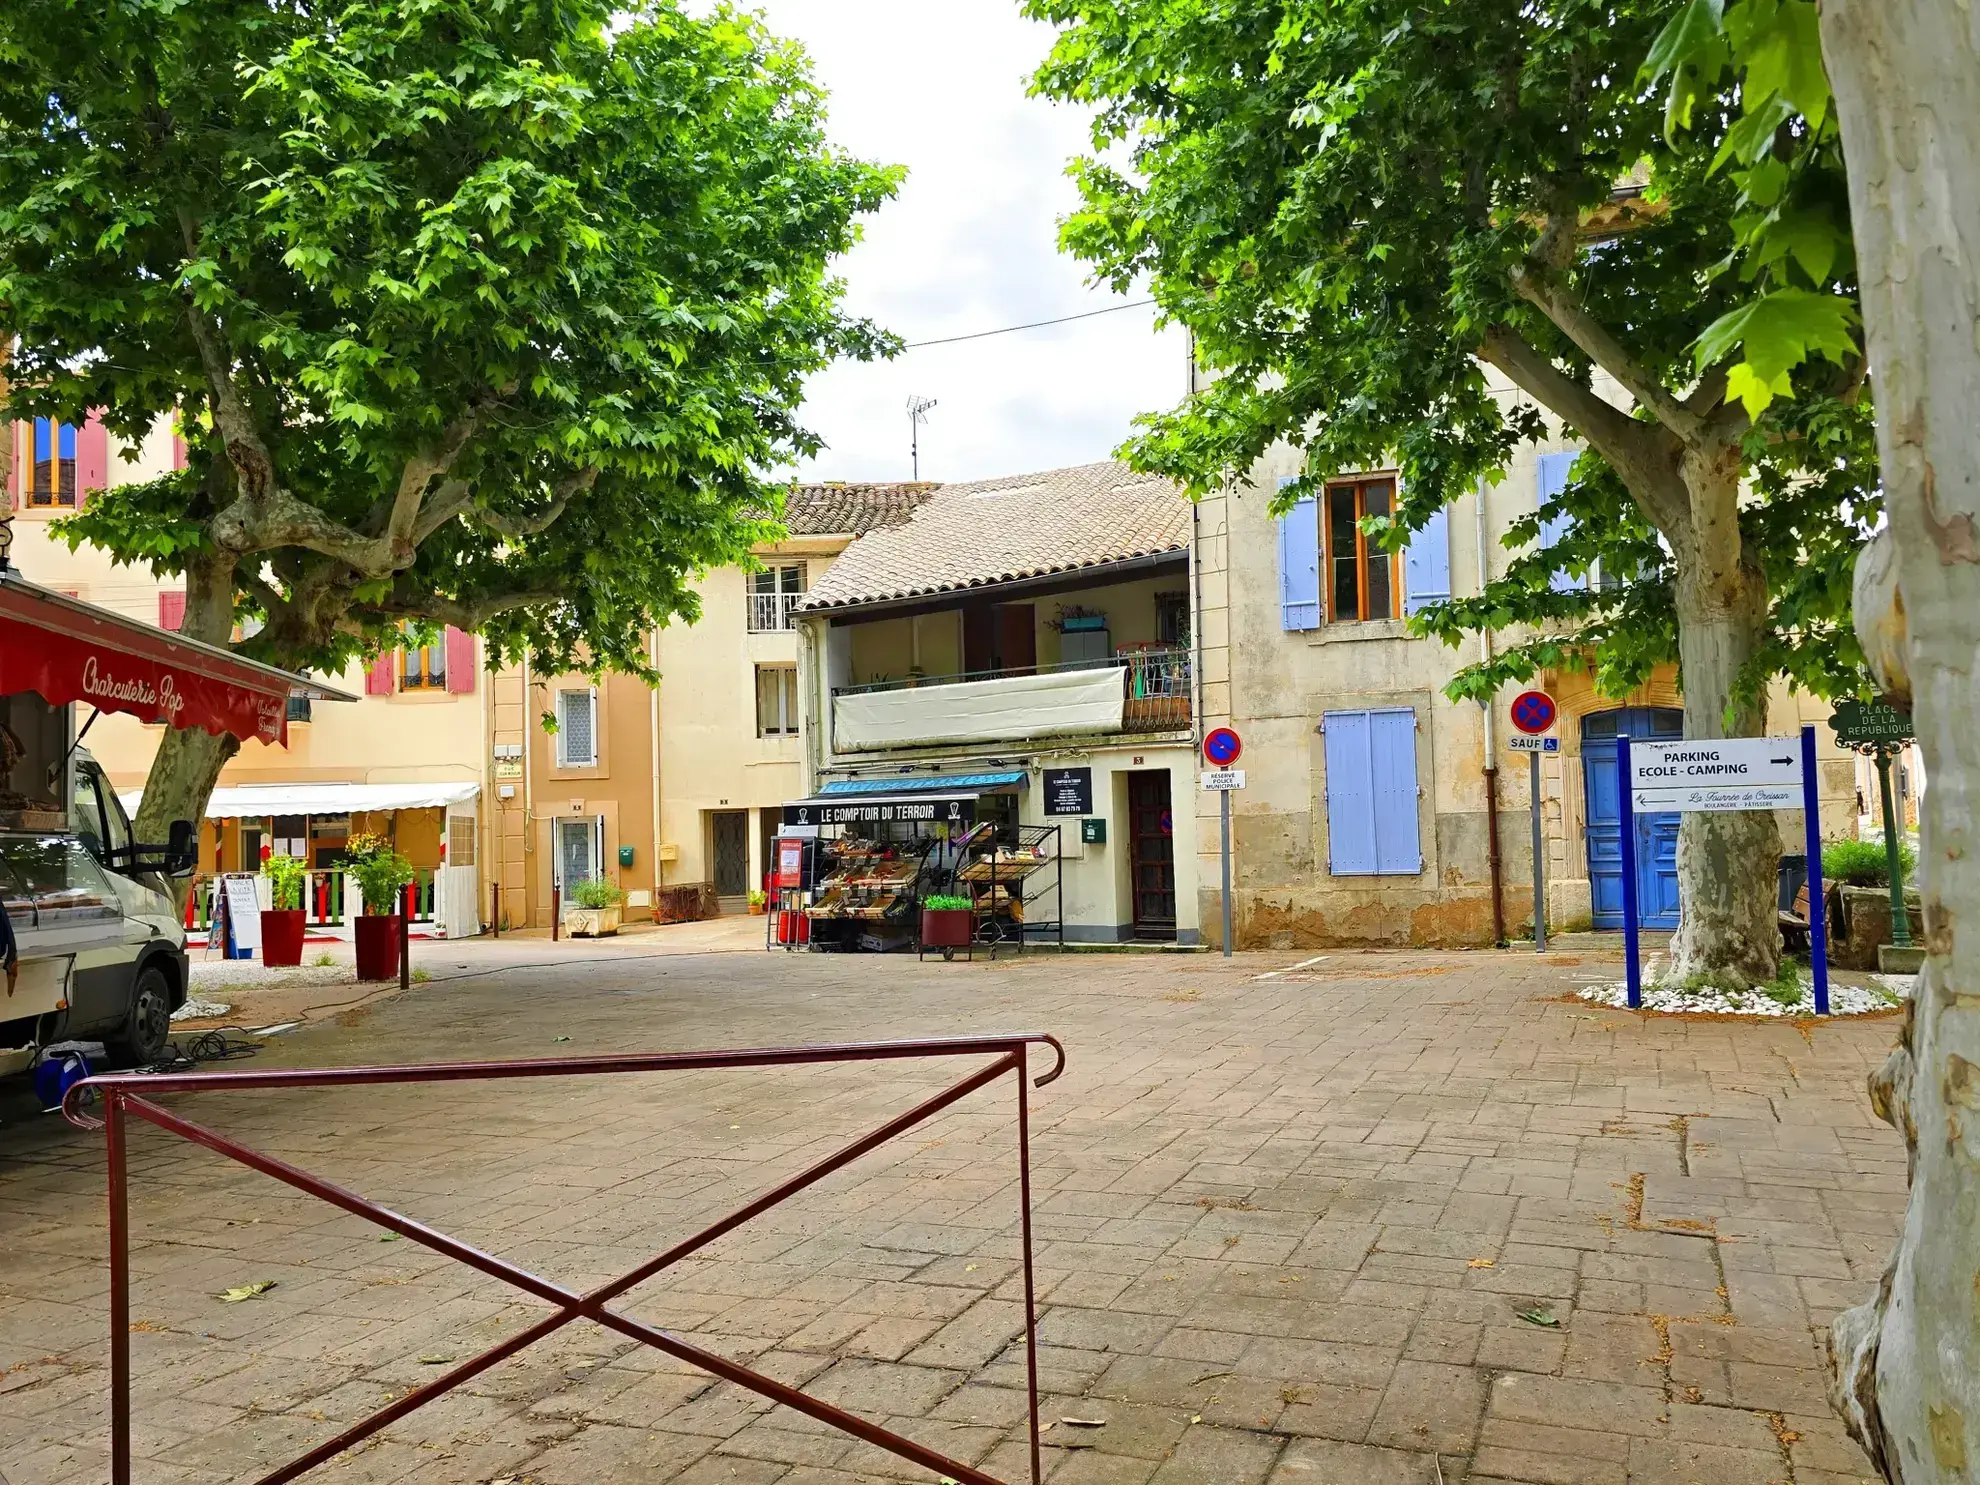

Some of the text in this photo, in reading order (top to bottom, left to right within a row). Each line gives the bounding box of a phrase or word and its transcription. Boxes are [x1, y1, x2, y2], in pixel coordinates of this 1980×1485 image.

[82, 655, 185, 717] Charcuterie Pop
[1859, 704, 1897, 715] PLACE
[1862, 715, 1896, 725] DE LA
[1847, 723, 1912, 736] REPUBLIQUE
[1510, 738, 1541, 748] SAUF
[1664, 751, 1720, 763] PARKING
[1639, 766, 1677, 777] ECOLE
[1687, 763, 1748, 775] CAMPING
[1687, 792, 1703, 802] La
[1742, 791, 1753, 801] de
[821, 804, 935, 823] LE COMPTOIR DU TERROIR
